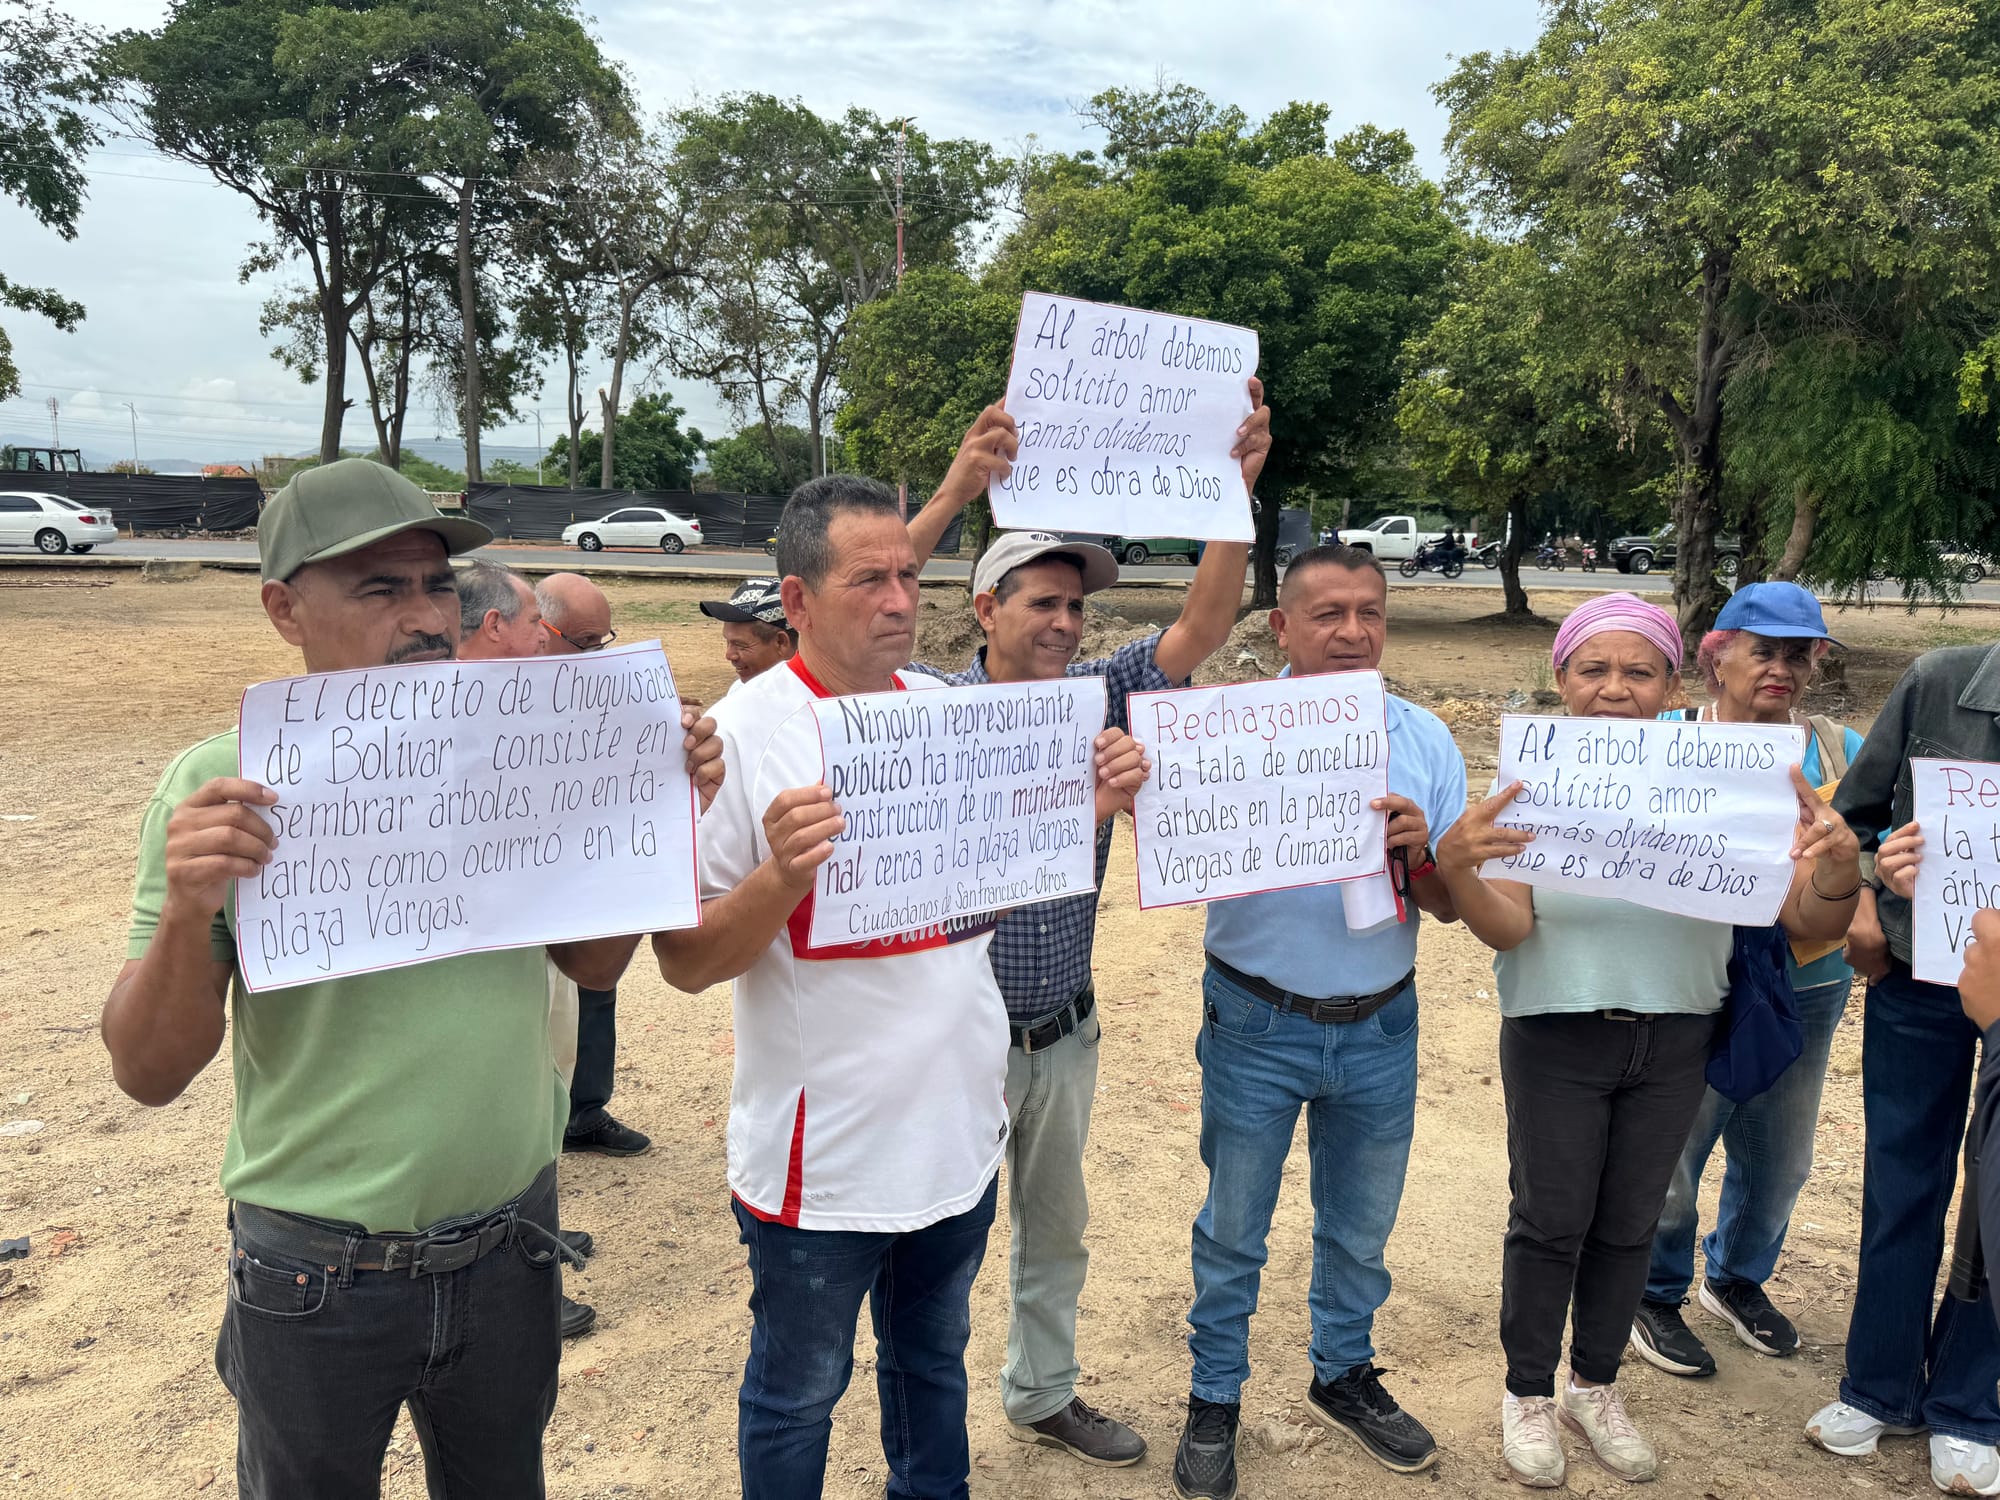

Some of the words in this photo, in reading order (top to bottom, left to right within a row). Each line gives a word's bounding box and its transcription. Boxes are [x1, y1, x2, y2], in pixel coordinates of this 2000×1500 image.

[1034, 303, 1075, 350] Al
[1092, 317, 1149, 360] árbol
[1162, 325, 1243, 374] debemos
[1025, 359, 1128, 408] solícito
[1139, 384, 1197, 415] amor
[1094, 418, 1191, 457] olvidemos
[1000, 465, 1040, 503] que
[1057, 465, 1078, 495] es
[1091, 456, 1141, 496] obra
[1152, 465, 1171, 497] de
[1176, 465, 1221, 502] Dios
[284, 678, 328, 723] El
[346, 670, 484, 721] decreto
[499, 666, 532, 716] de
[552, 660, 676, 723] Chuquisaca
[838, 696, 931, 752] Ningún
[943, 686, 1074, 742] representante
[1150, 694, 1359, 743] Rechazamos
[266, 729, 302, 786] de
[325, 725, 453, 784] Bolívar
[492, 719, 623, 771] consiste
[636, 720, 668, 755] en
[832, 753, 912, 799] público
[921, 742, 947, 788] ha
[955, 734, 1040, 788] informado
[1048, 729, 1063, 770] de
[1072, 723, 1087, 766] la
[1158, 750, 1182, 792] la
[1196, 744, 1246, 785] tala
[1263, 742, 1285, 778] de
[1518, 722, 1556, 763] Al
[1577, 726, 1648, 765] árbol
[1666, 726, 1775, 770] debemos
[271, 787, 414, 839] sembrar
[430, 776, 540, 831] árboles,
[551, 778, 583, 814] no
[592, 774, 618, 806] en
[828, 791, 948, 842] onstrucción
[958, 785, 976, 825] de
[983, 788, 1003, 822] un
[1156, 794, 1238, 838] árboles
[1248, 799, 1268, 827] en
[1280, 785, 1297, 825] la
[1306, 782, 1361, 833] plaza
[1513, 767, 1631, 810] solícito
[1649, 784, 1717, 814] amor
[367, 848, 447, 889] como
[463, 822, 562, 878] ocurrió
[584, 825, 614, 862] en
[632, 814, 657, 858] la
[826, 845, 867, 897] nal
[875, 851, 922, 886] cerca
[935, 844, 944, 875] a
[952, 828, 969, 868] la
[976, 825, 1019, 878] plaza
[1028, 817, 1084, 862] Vargas.
[1154, 847, 1232, 894] Vargas
[1242, 837, 1261, 874] de
[1275, 824, 1360, 868] Cumaná
[1605, 817, 1727, 859] olvidemos
[1943, 814, 1973, 861] la
[1501, 853, 1545, 871] que
[1560, 853, 1588, 879] es
[1601, 849, 1656, 880] obra
[1668, 860, 1693, 888] de
[1698, 862, 1758, 897] Dios
[261, 902, 345, 976] plaza
[366, 887, 470, 952] Vargas.
[850, 896, 938, 935] Ciudadanos
